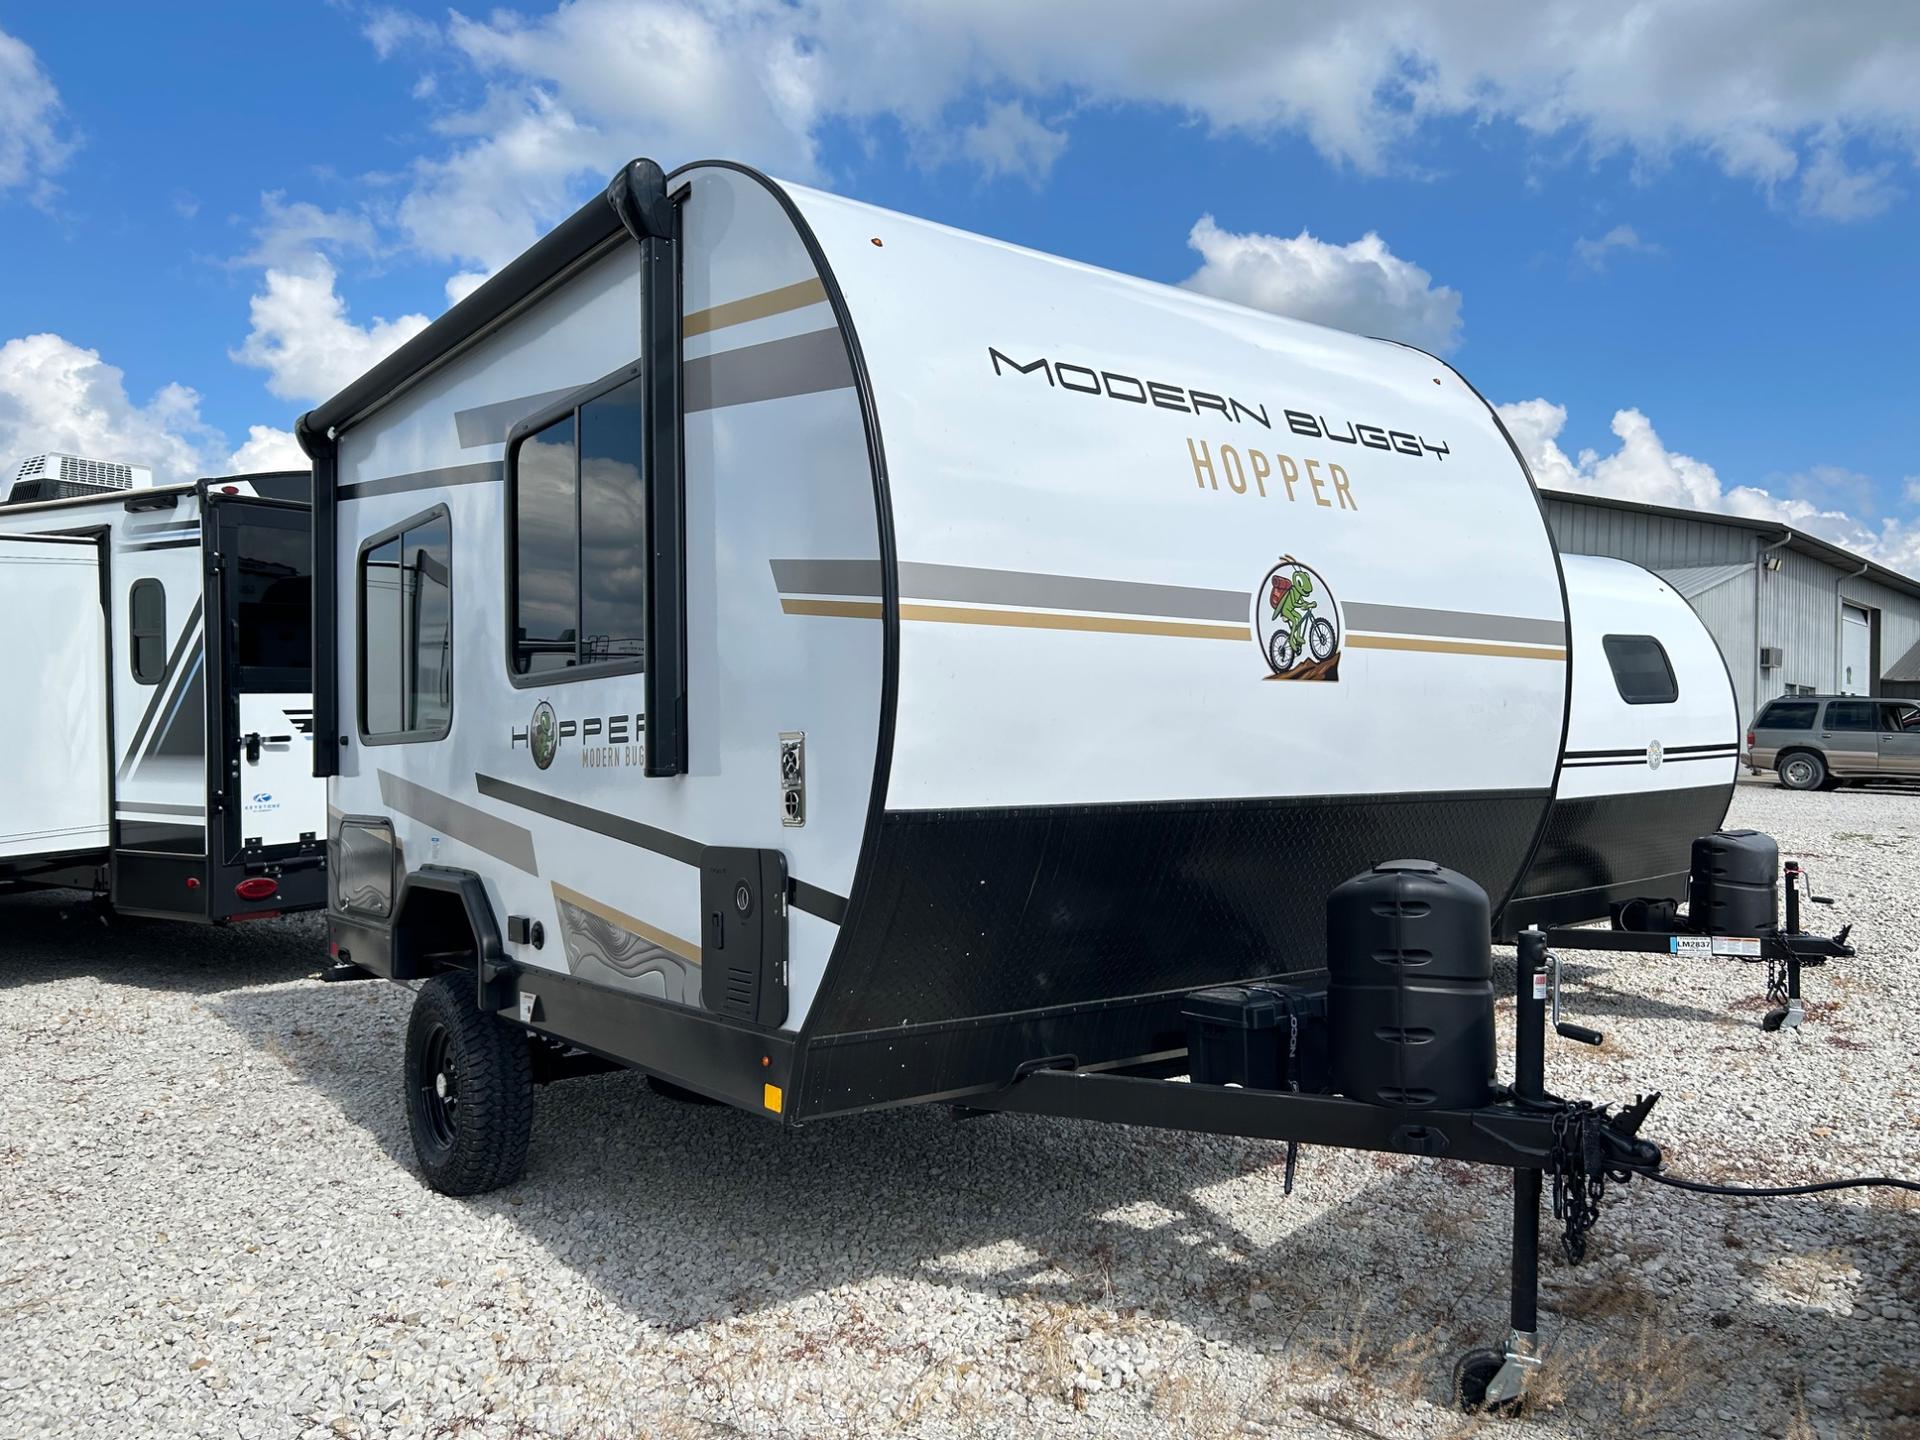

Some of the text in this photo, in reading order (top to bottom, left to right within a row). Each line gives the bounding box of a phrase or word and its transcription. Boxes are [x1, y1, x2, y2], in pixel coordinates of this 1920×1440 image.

[988, 346, 1450, 461] MODERN BUGGY
[1186, 437, 1358, 511] HOPPER
[582, 745, 645, 768] MODERN BUG
[1289, 1016, 1298, 1058] NOCO
